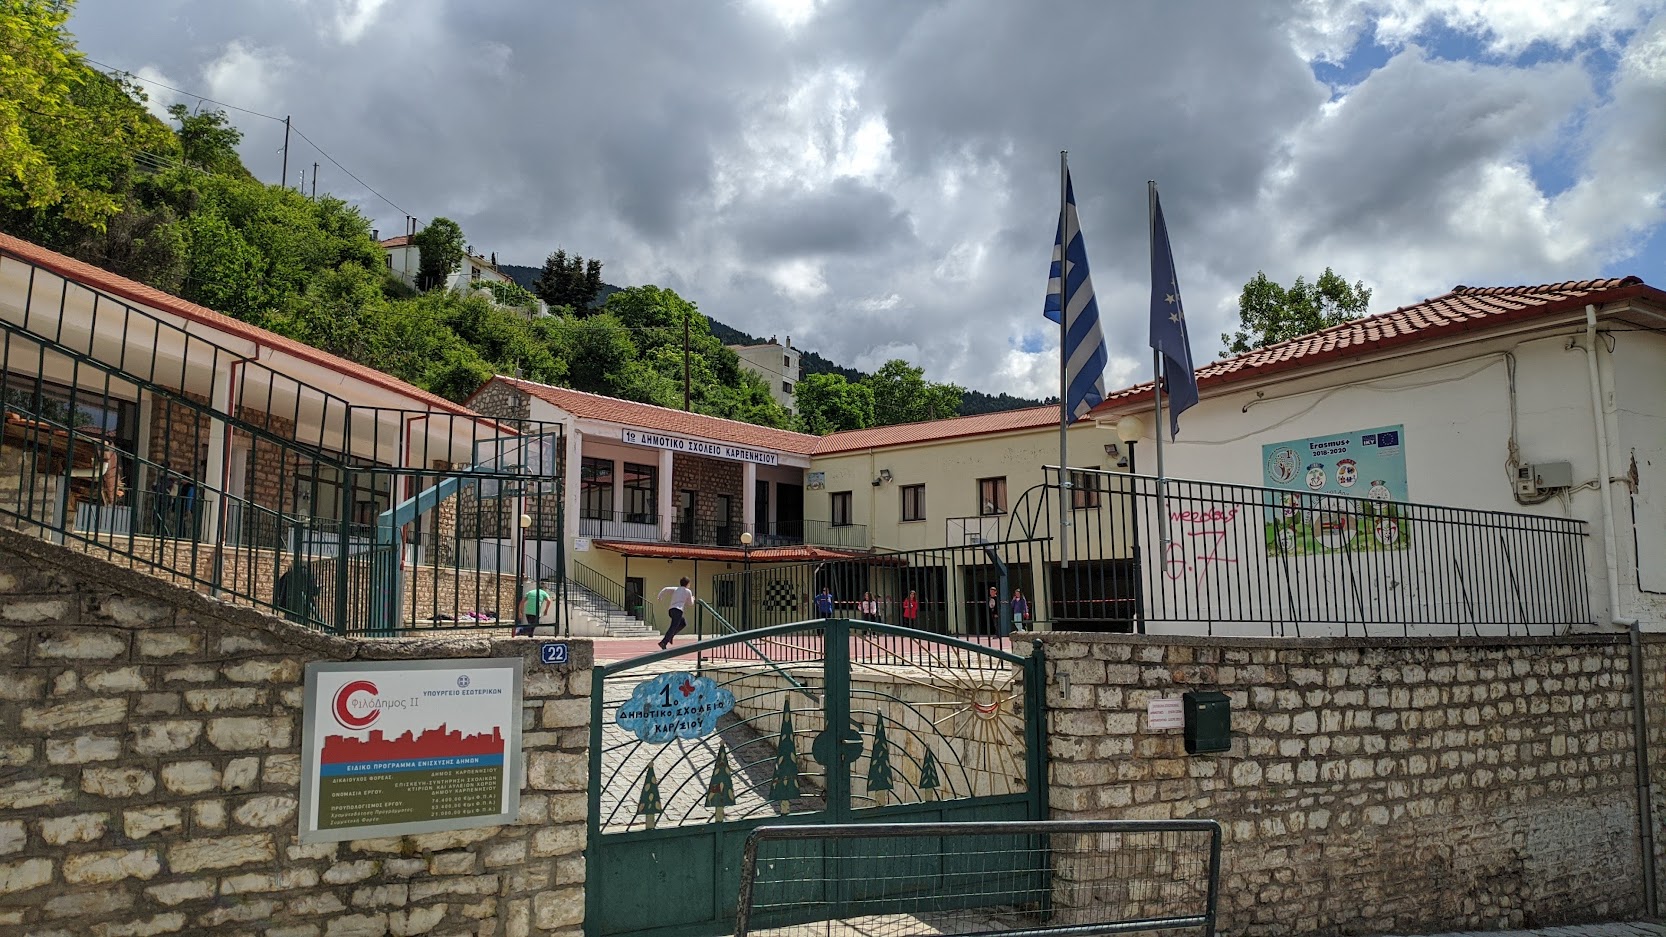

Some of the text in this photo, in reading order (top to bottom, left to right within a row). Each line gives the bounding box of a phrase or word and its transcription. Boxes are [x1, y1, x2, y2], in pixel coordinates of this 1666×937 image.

[641, 434, 684, 450] ΔΗΜΟΤΙΚΟ
[688, 442, 721, 456] ΣΧΟΛΕΙΟ
[726, 448, 775, 464] ΚΑΡΠΕΝΗΣΙΟΥ
[1309, 438, 1351, 450] Erasmus+
[1312, 447, 1347, 457] 2018-2020
[548, 646, 563, 660] 22
[423, 688, 502, 698] ΥΠΟΥΡΓΕΙΟ ΕΣΩΤΕΡΙΚΩΝ
[351, 698, 406, 710] ΦιλόΔημος
[620, 702, 724, 720] ΔΗΜΟΤΙΚΟ ΣΧΟΛΕΙΟ
[655, 720, 704, 733] ΚΑΡ/ΣΙΟΥ
[346, 764, 371, 772] ΕΙΔΙΚΟ
[373, 762, 416, 770] ΠΡΟΓΡΑΜΜΑ
[418, 759, 454, 767] ΕΝΙΣΧΥΣΗΣ
[332, 776, 367, 784] ΔΙΚΑΙΟΥΧΟΣ
[332, 790, 362, 798] ΟΝΟΜΑΣΙΑ
[455, 786, 497, 794] ΚΑΡΠΕΝΗΣΙΟΥ
[330, 802, 383, 811] ΠΡΟΥΠΟΛΟΓΙΣΜΟΣ
